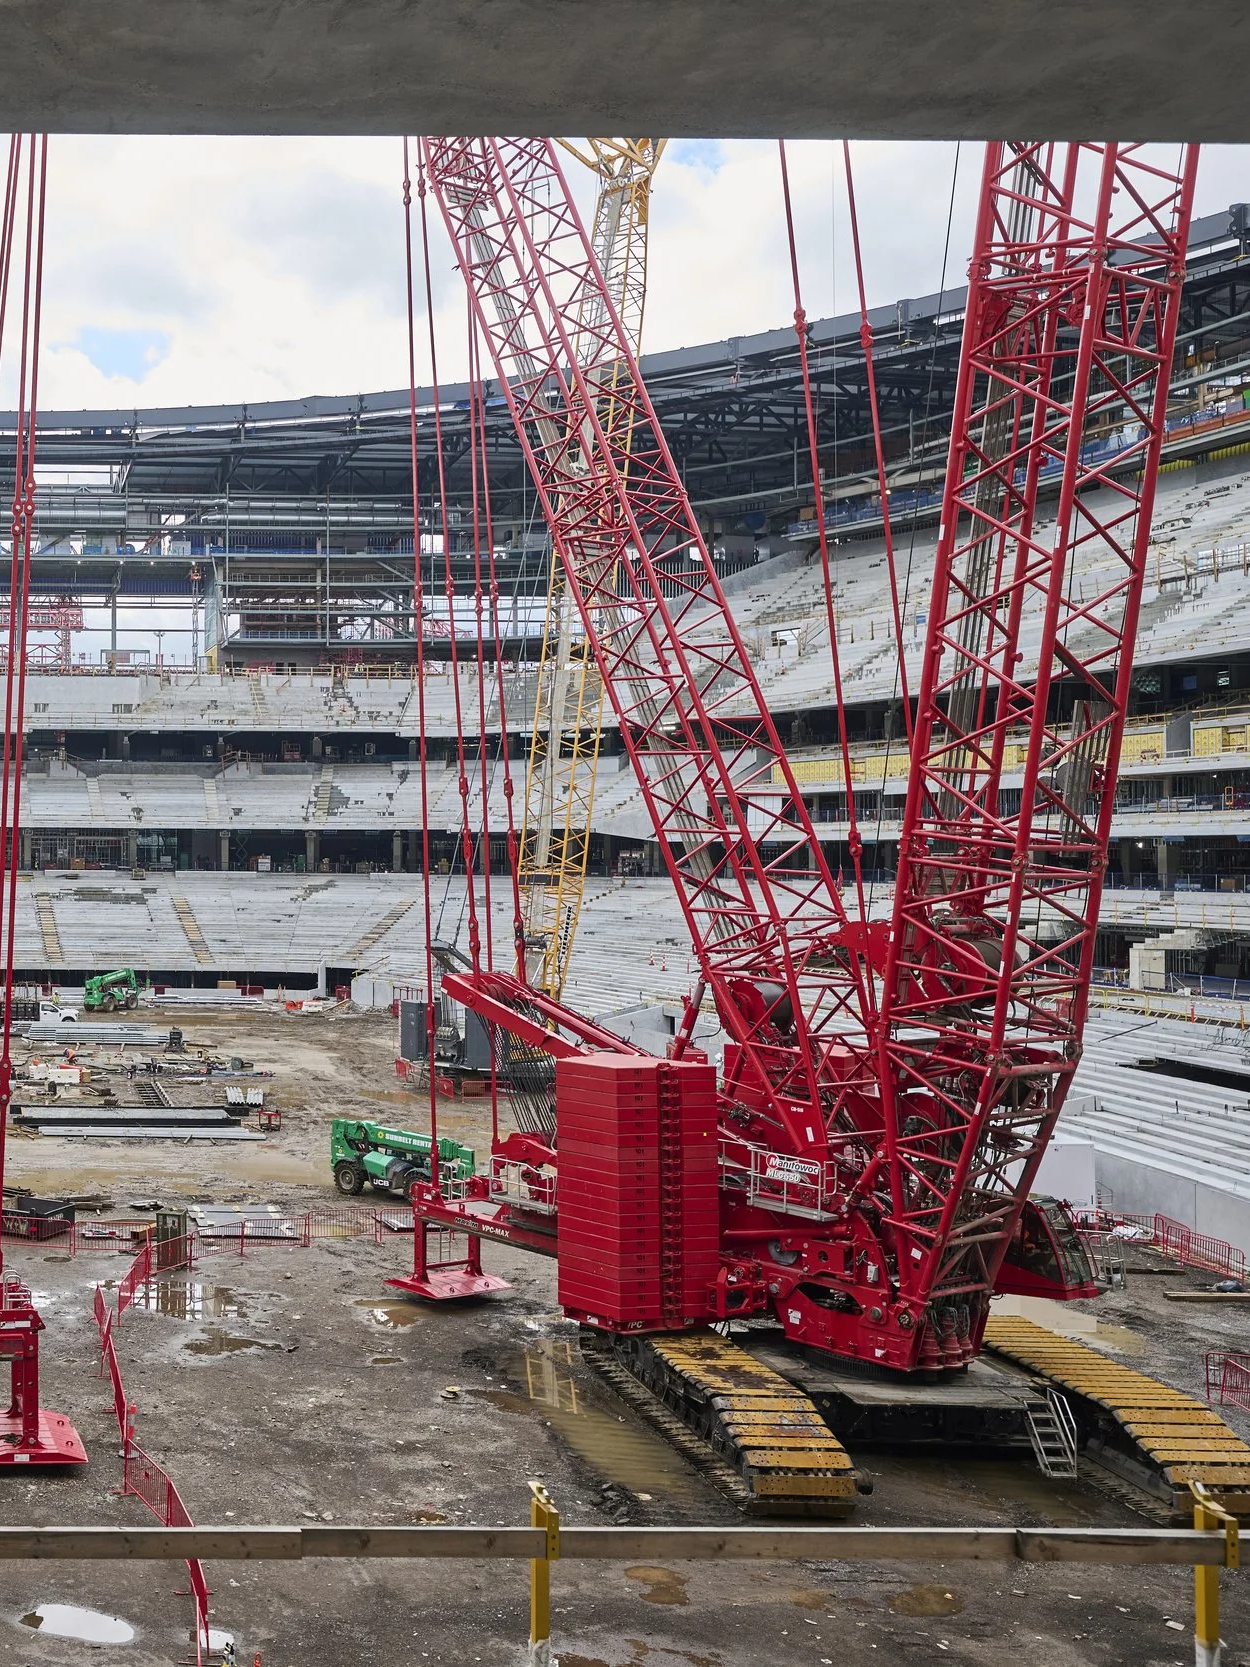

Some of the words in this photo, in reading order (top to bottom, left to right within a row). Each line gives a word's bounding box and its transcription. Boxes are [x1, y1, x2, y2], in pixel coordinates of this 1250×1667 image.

[385, 1133, 412, 1144] SUNBELT
[768, 1156, 819, 1174] Manitowoc
[373, 1178, 390, 1187] JCB
[481, 1224, 510, 1238] VPC-MAX
